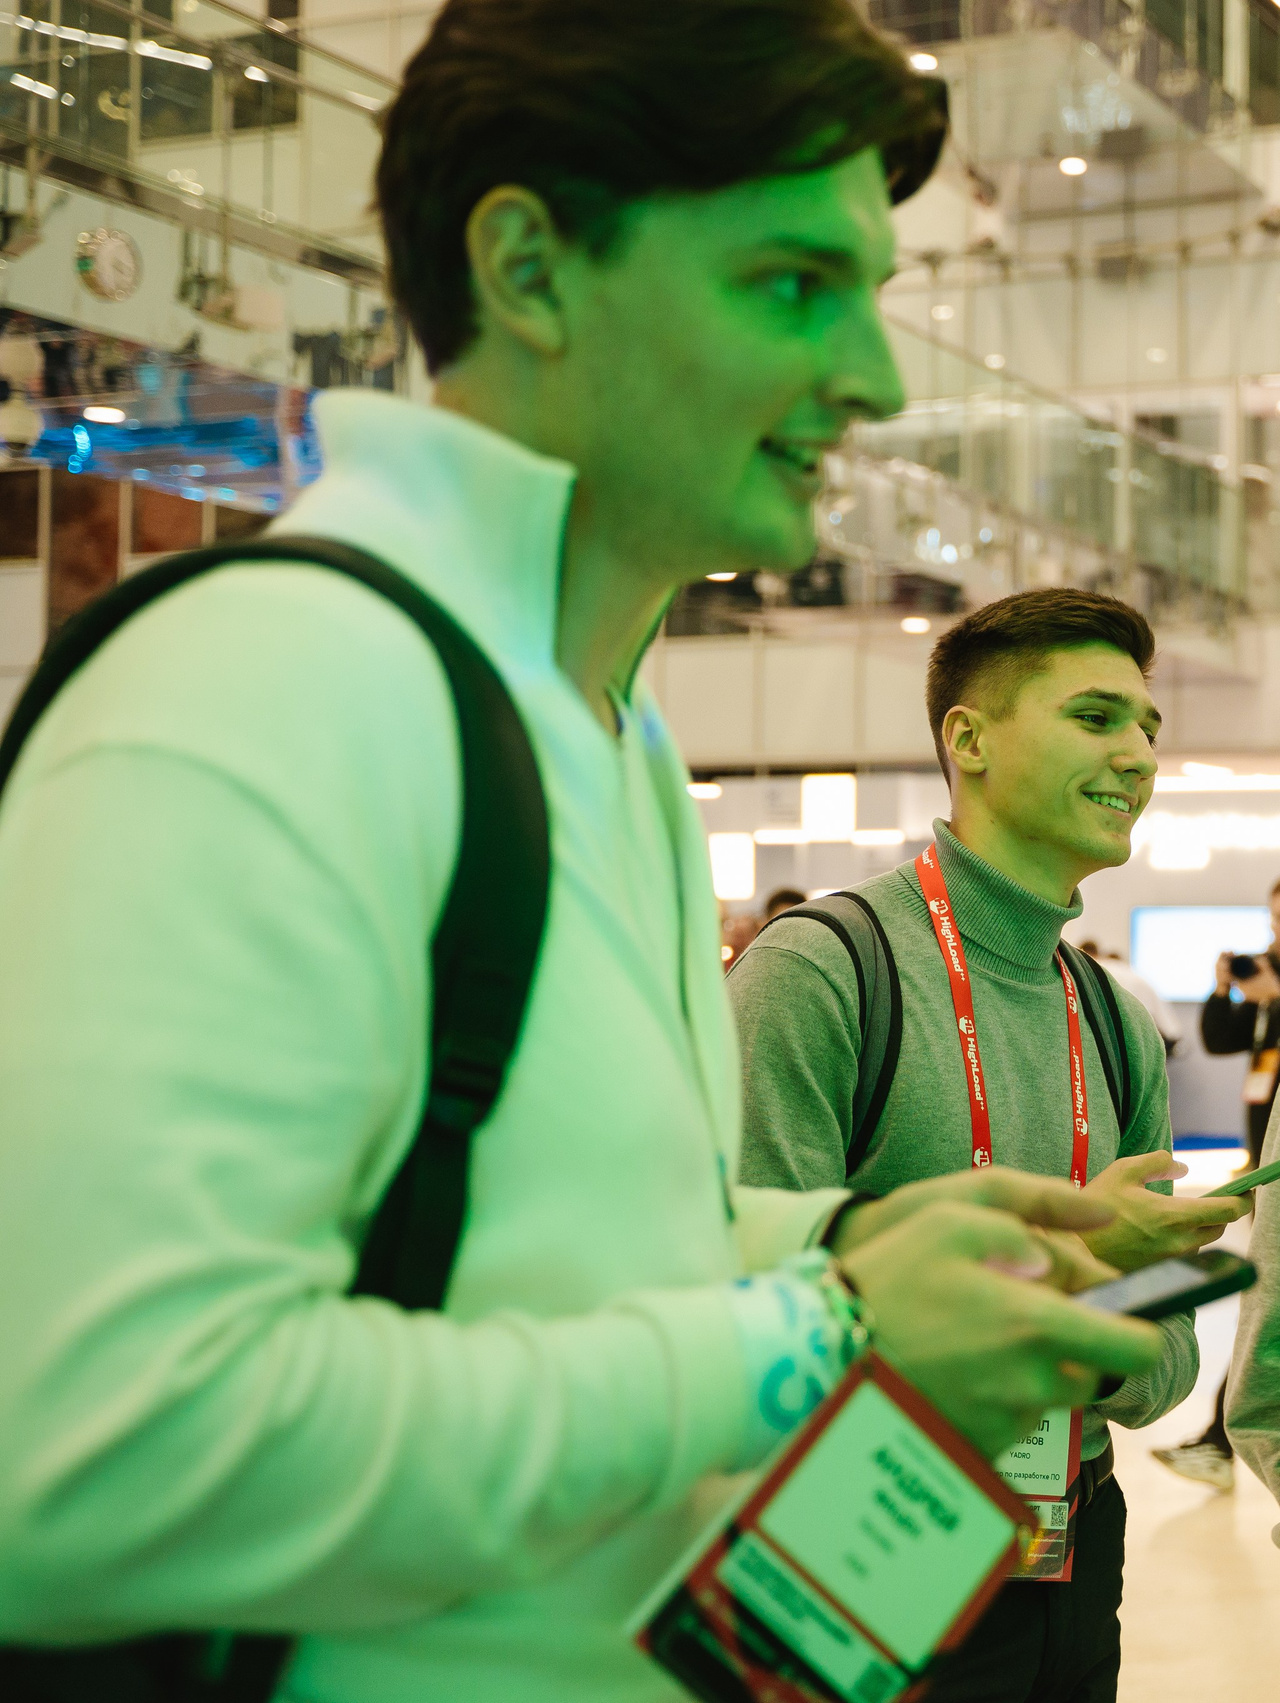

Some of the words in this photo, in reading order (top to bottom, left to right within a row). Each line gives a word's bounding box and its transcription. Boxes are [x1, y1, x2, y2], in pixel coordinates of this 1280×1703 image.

[1009, 1451, 1031, 1460] YADRO
[1014, 1471, 1049, 1480] разработке
[1050, 1473, 1060, 1481] ПО
